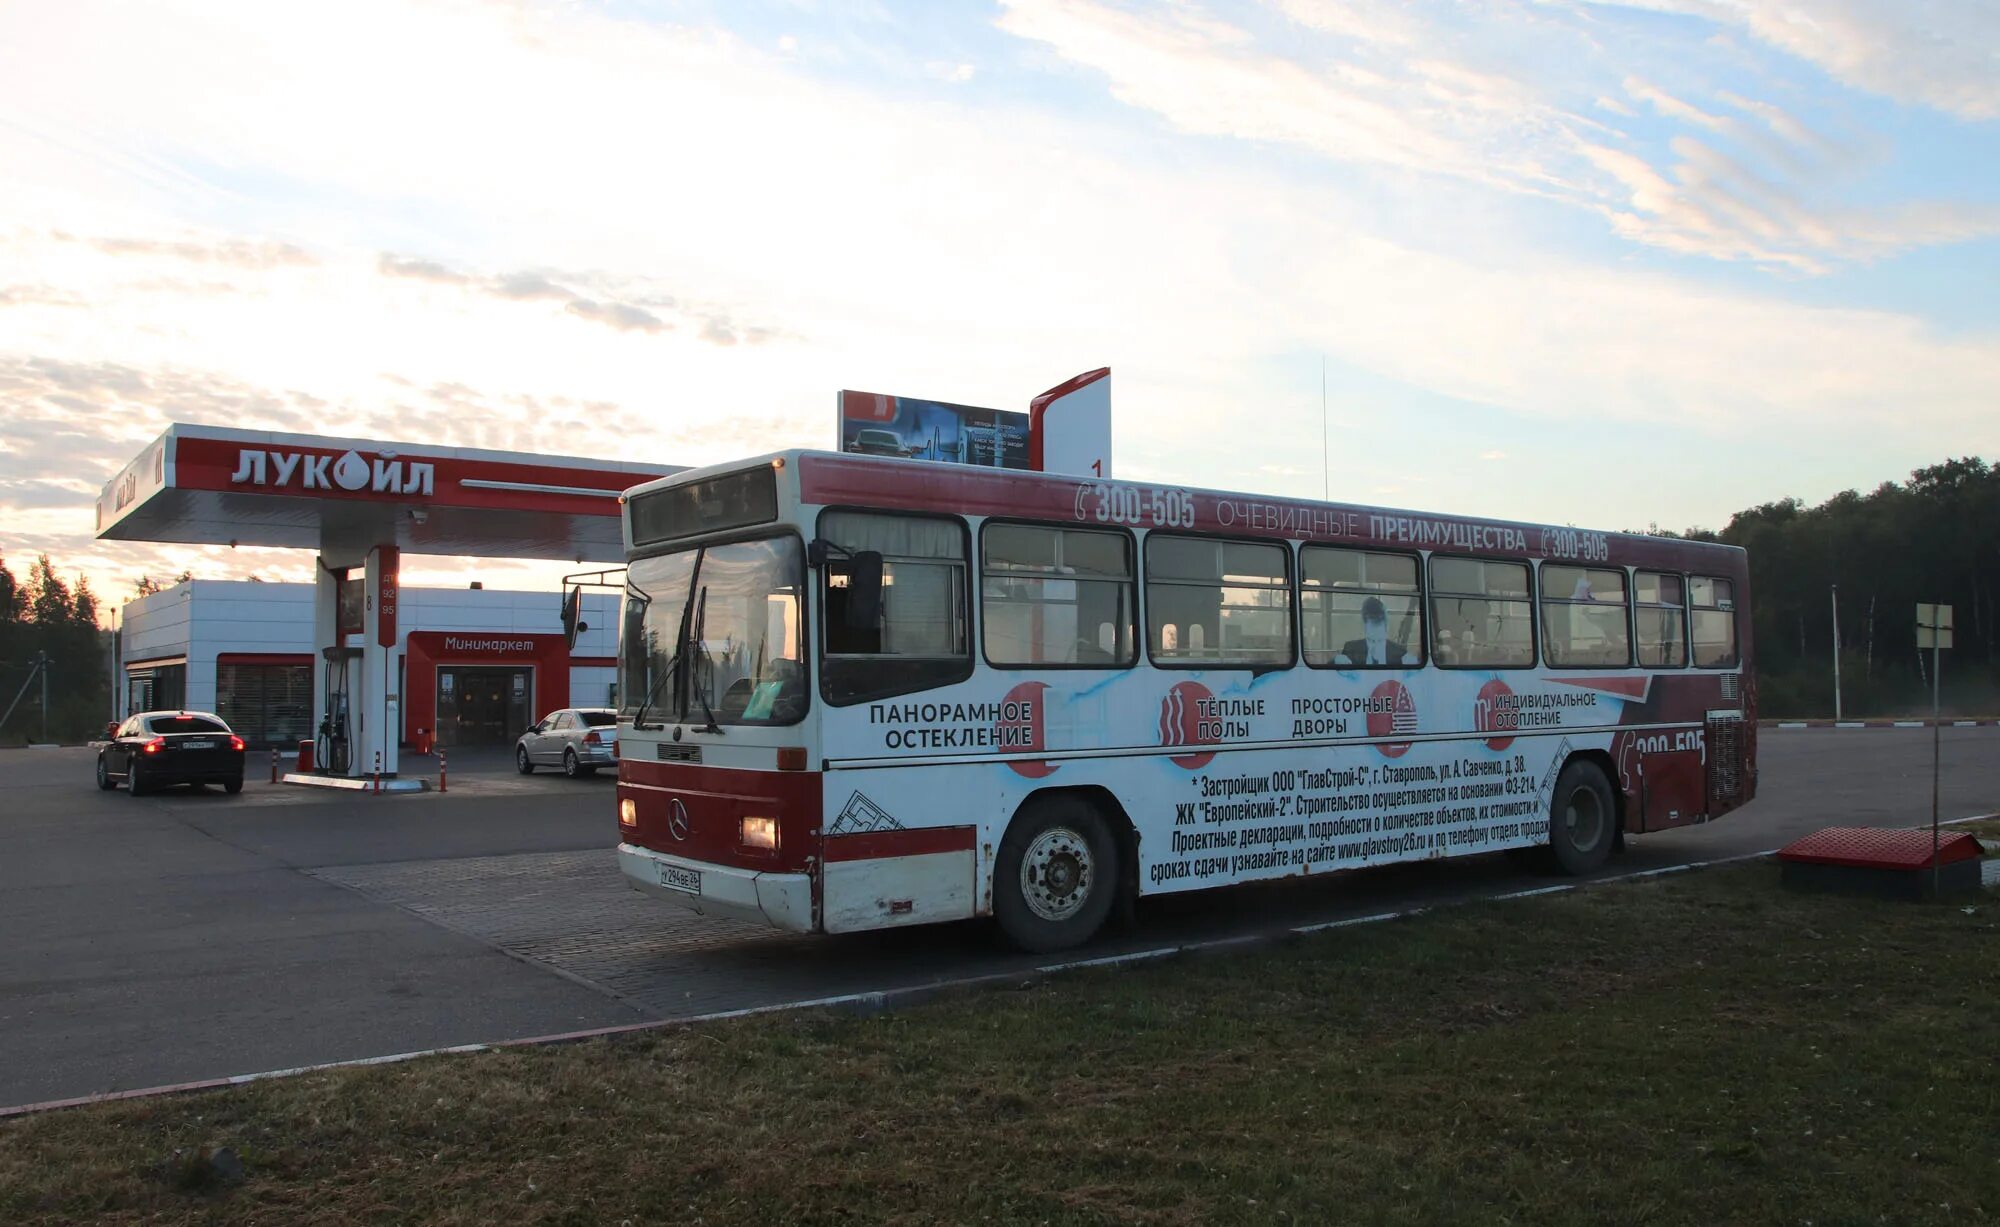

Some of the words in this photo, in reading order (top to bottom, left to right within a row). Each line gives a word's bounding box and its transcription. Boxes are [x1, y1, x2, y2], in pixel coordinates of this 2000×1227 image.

[231, 448, 434, 496] ЛУКОЙЛ
[1095, 484, 1195, 528] 300-505
[1216, 500, 1358, 538] ОЧЕВИДНЫЕ
[1370, 515, 1527, 551] ПРЕИМУЩЕСТВА
[1553, 531, 1609, 561] 300-505
[383, 589, 395, 598] 92
[382, 606, 395, 615] 95
[445, 637, 534, 654] Минимаркет
[870, 702, 1032, 723] ПАНОРАМНОЕ
[1197, 696, 1265, 717] ТЁПЛЫЕ
[1291, 696, 1393, 715] ПРОСТОРНЫЕ
[1495, 693, 1597, 711] ИНДИВИДУАЛЬНОЕ
[1292, 718, 1347, 738] ДВОРЫ
[1496, 711, 1561, 727] ОТОПЛЕНИЕ
[885, 726, 1033, 749] ОСТЕКЛЕНИЕ
[1198, 721, 1249, 739] ПОЛЫ
[1201, 774, 1270, 800] Застройщик
[1272, 770, 1295, 793] ООО
[1297, 765, 1371, 792] "ГлавСтрой-С",
[1373, 770, 1381, 785] г.
[1383, 764, 1437, 787] Ставрополь,
[1463, 758, 1503, 778] Савченко,
[1514, 755, 1527, 773] 38.
[1175, 803, 1196, 826] ЖК
[1199, 796, 1294, 827] "Европейский-2".
[1296, 794, 1370, 818] Строительство
[1372, 786, 1446, 812] осуществляется
[1448, 786, 1459, 800] на
[1461, 781, 1504, 799] основании
[1505, 775, 1537, 794] ФЗ-214.
[1171, 830, 1237, 856] Проектные
[1239, 824, 1306, 848] декларации,
[1308, 815, 1372, 841] подробности
[1374, 817, 1380, 831] о
[1382, 812, 1433, 830] количестве
[1436, 806, 1478, 824] объектов,
[1479, 805, 1489, 819] их
[1490, 801, 1531, 818] стоимости
[1533, 800, 1539, 813] и
[1150, 860, 1191, 885] сроках
[1194, 856, 1228, 878] сдачи
[1231, 848, 1289, 876] узнавайте
[1291, 850, 1304, 864] на
[1307, 844, 1336, 864] сайте
[1338, 832, 1426, 860] www.glavstroy26.ru
[1428, 834, 1433, 848] и
[1436, 833, 1446, 848] по
[1449, 825, 1489, 847] телефону
[1490, 822, 1519, 841] отдела
